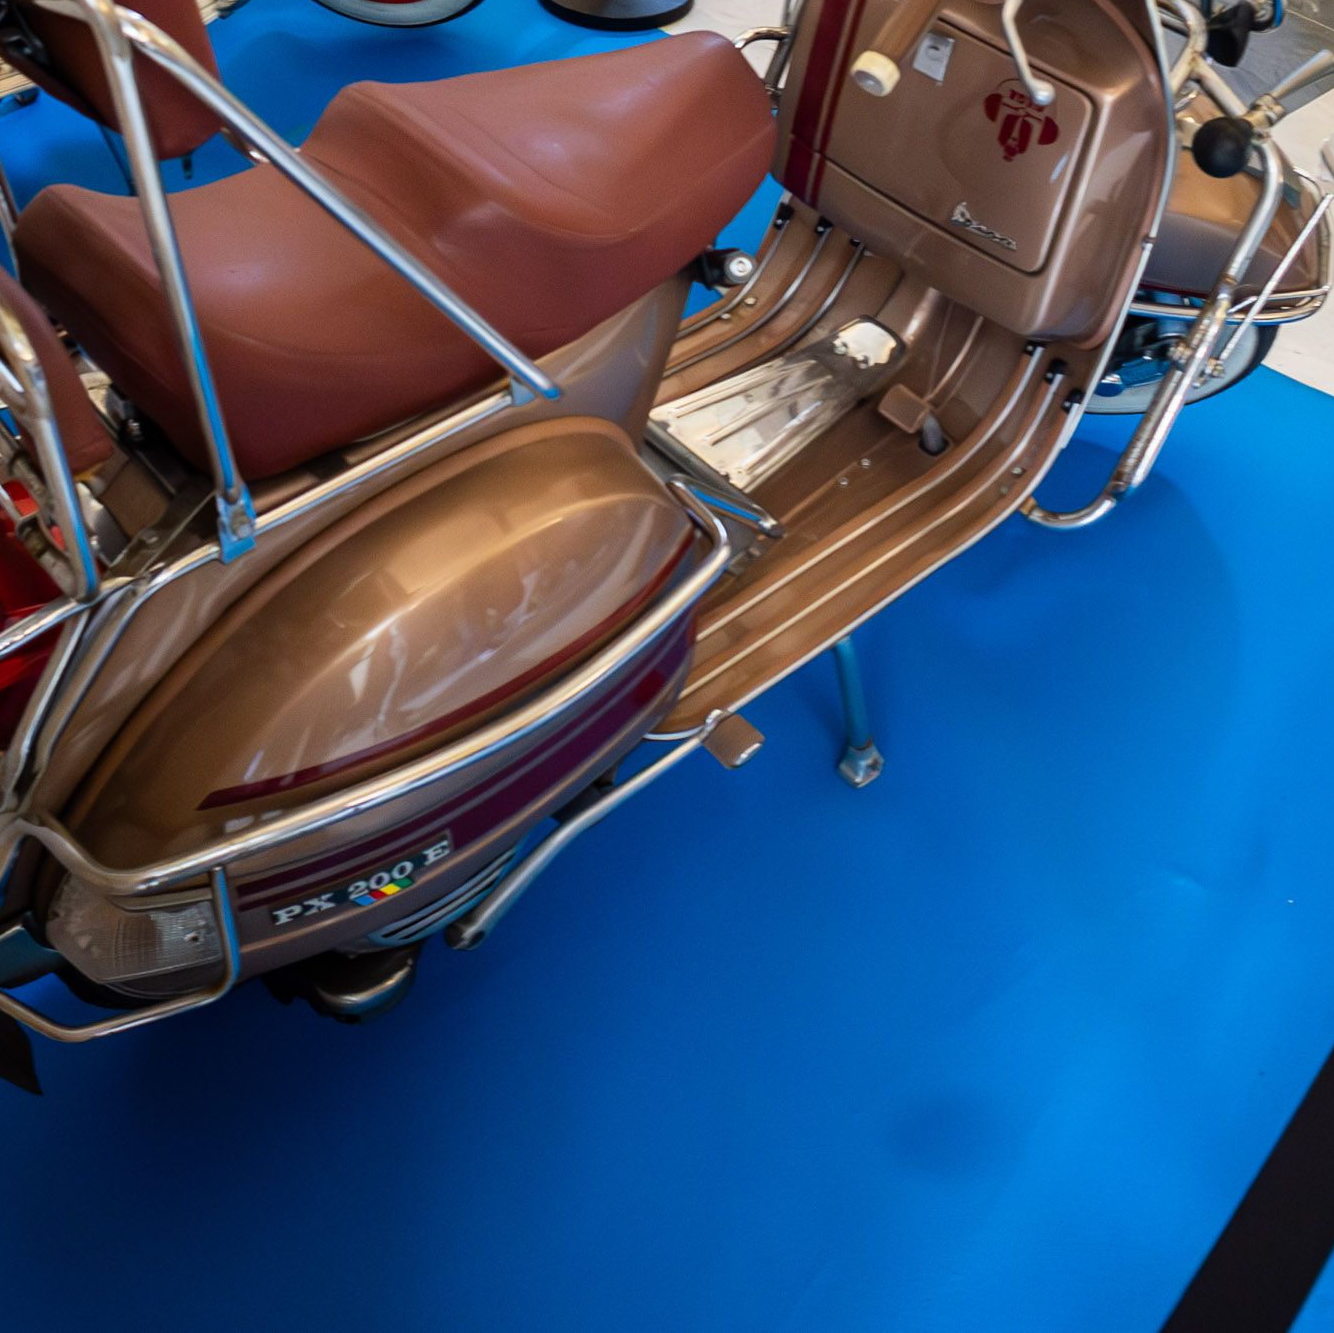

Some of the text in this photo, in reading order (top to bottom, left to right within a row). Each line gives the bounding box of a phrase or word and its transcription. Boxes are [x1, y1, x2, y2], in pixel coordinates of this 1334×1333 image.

[273, 839, 451, 926] PX 200 E
